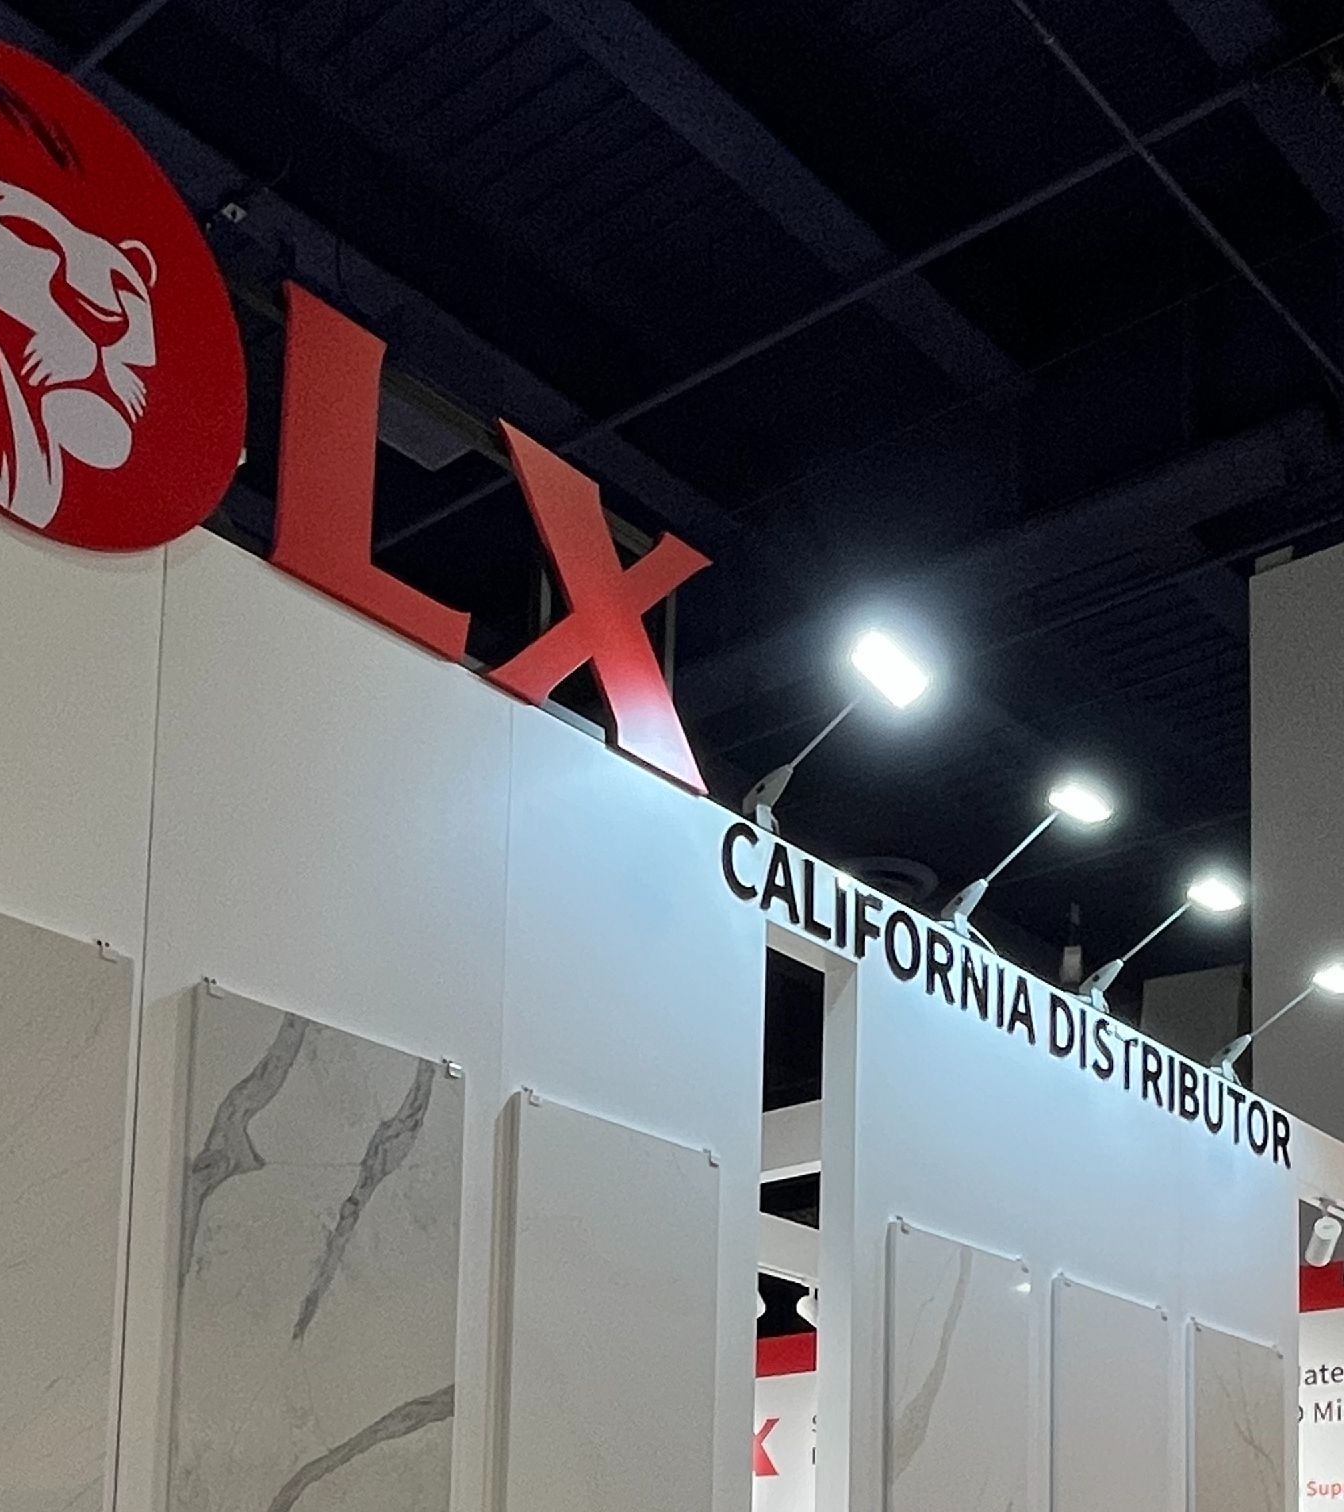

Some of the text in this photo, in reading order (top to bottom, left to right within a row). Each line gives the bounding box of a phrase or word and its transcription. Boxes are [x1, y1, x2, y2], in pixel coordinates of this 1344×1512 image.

[269, 278, 712, 796] LX
[720, 822, 1292, 1169] CALIFORNIA DISTRIBUTOR
